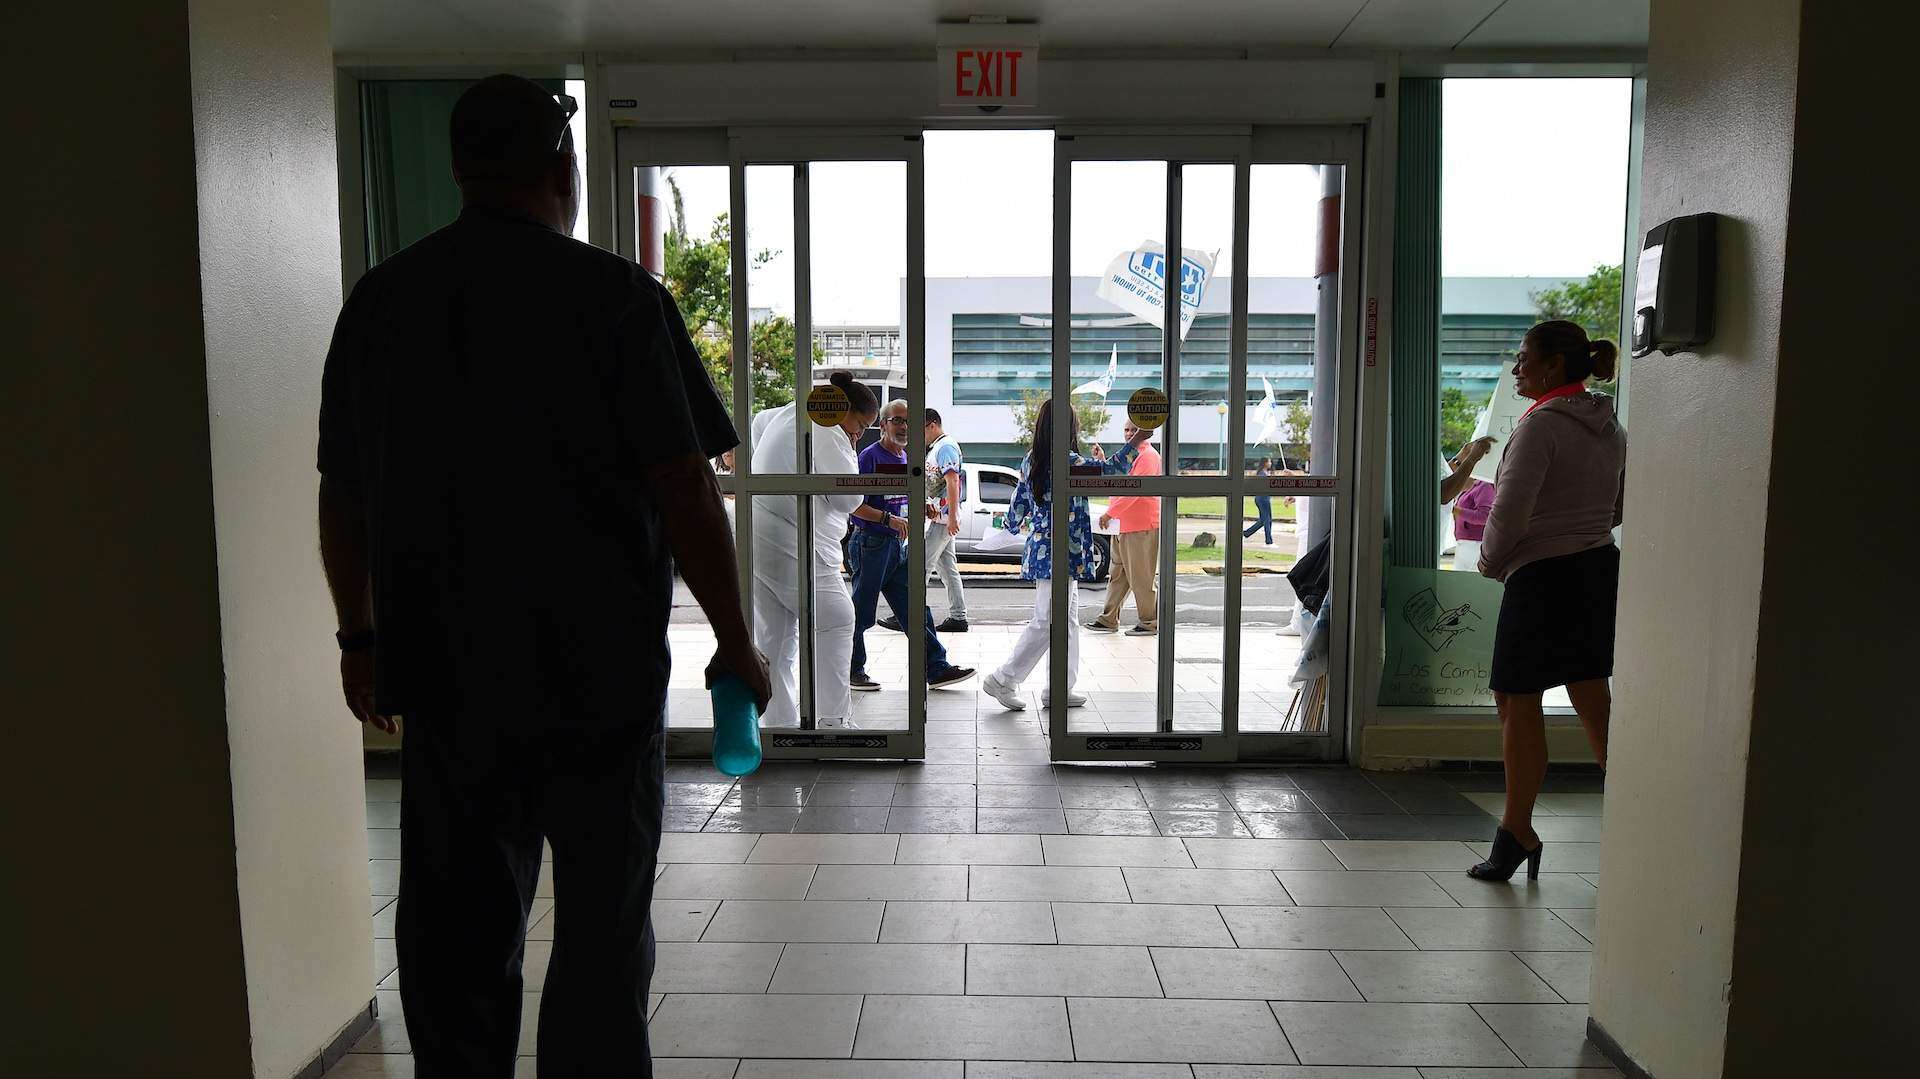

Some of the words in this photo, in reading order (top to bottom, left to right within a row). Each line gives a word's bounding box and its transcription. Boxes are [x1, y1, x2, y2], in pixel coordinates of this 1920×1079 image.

[956, 51, 1022, 96] EXIT
[808, 403, 847, 411] CAUTION
[1129, 405, 1168, 413] CAUTION
[1271, 479, 1296, 488] CAUTION
[1394, 648, 1431, 678] Los
